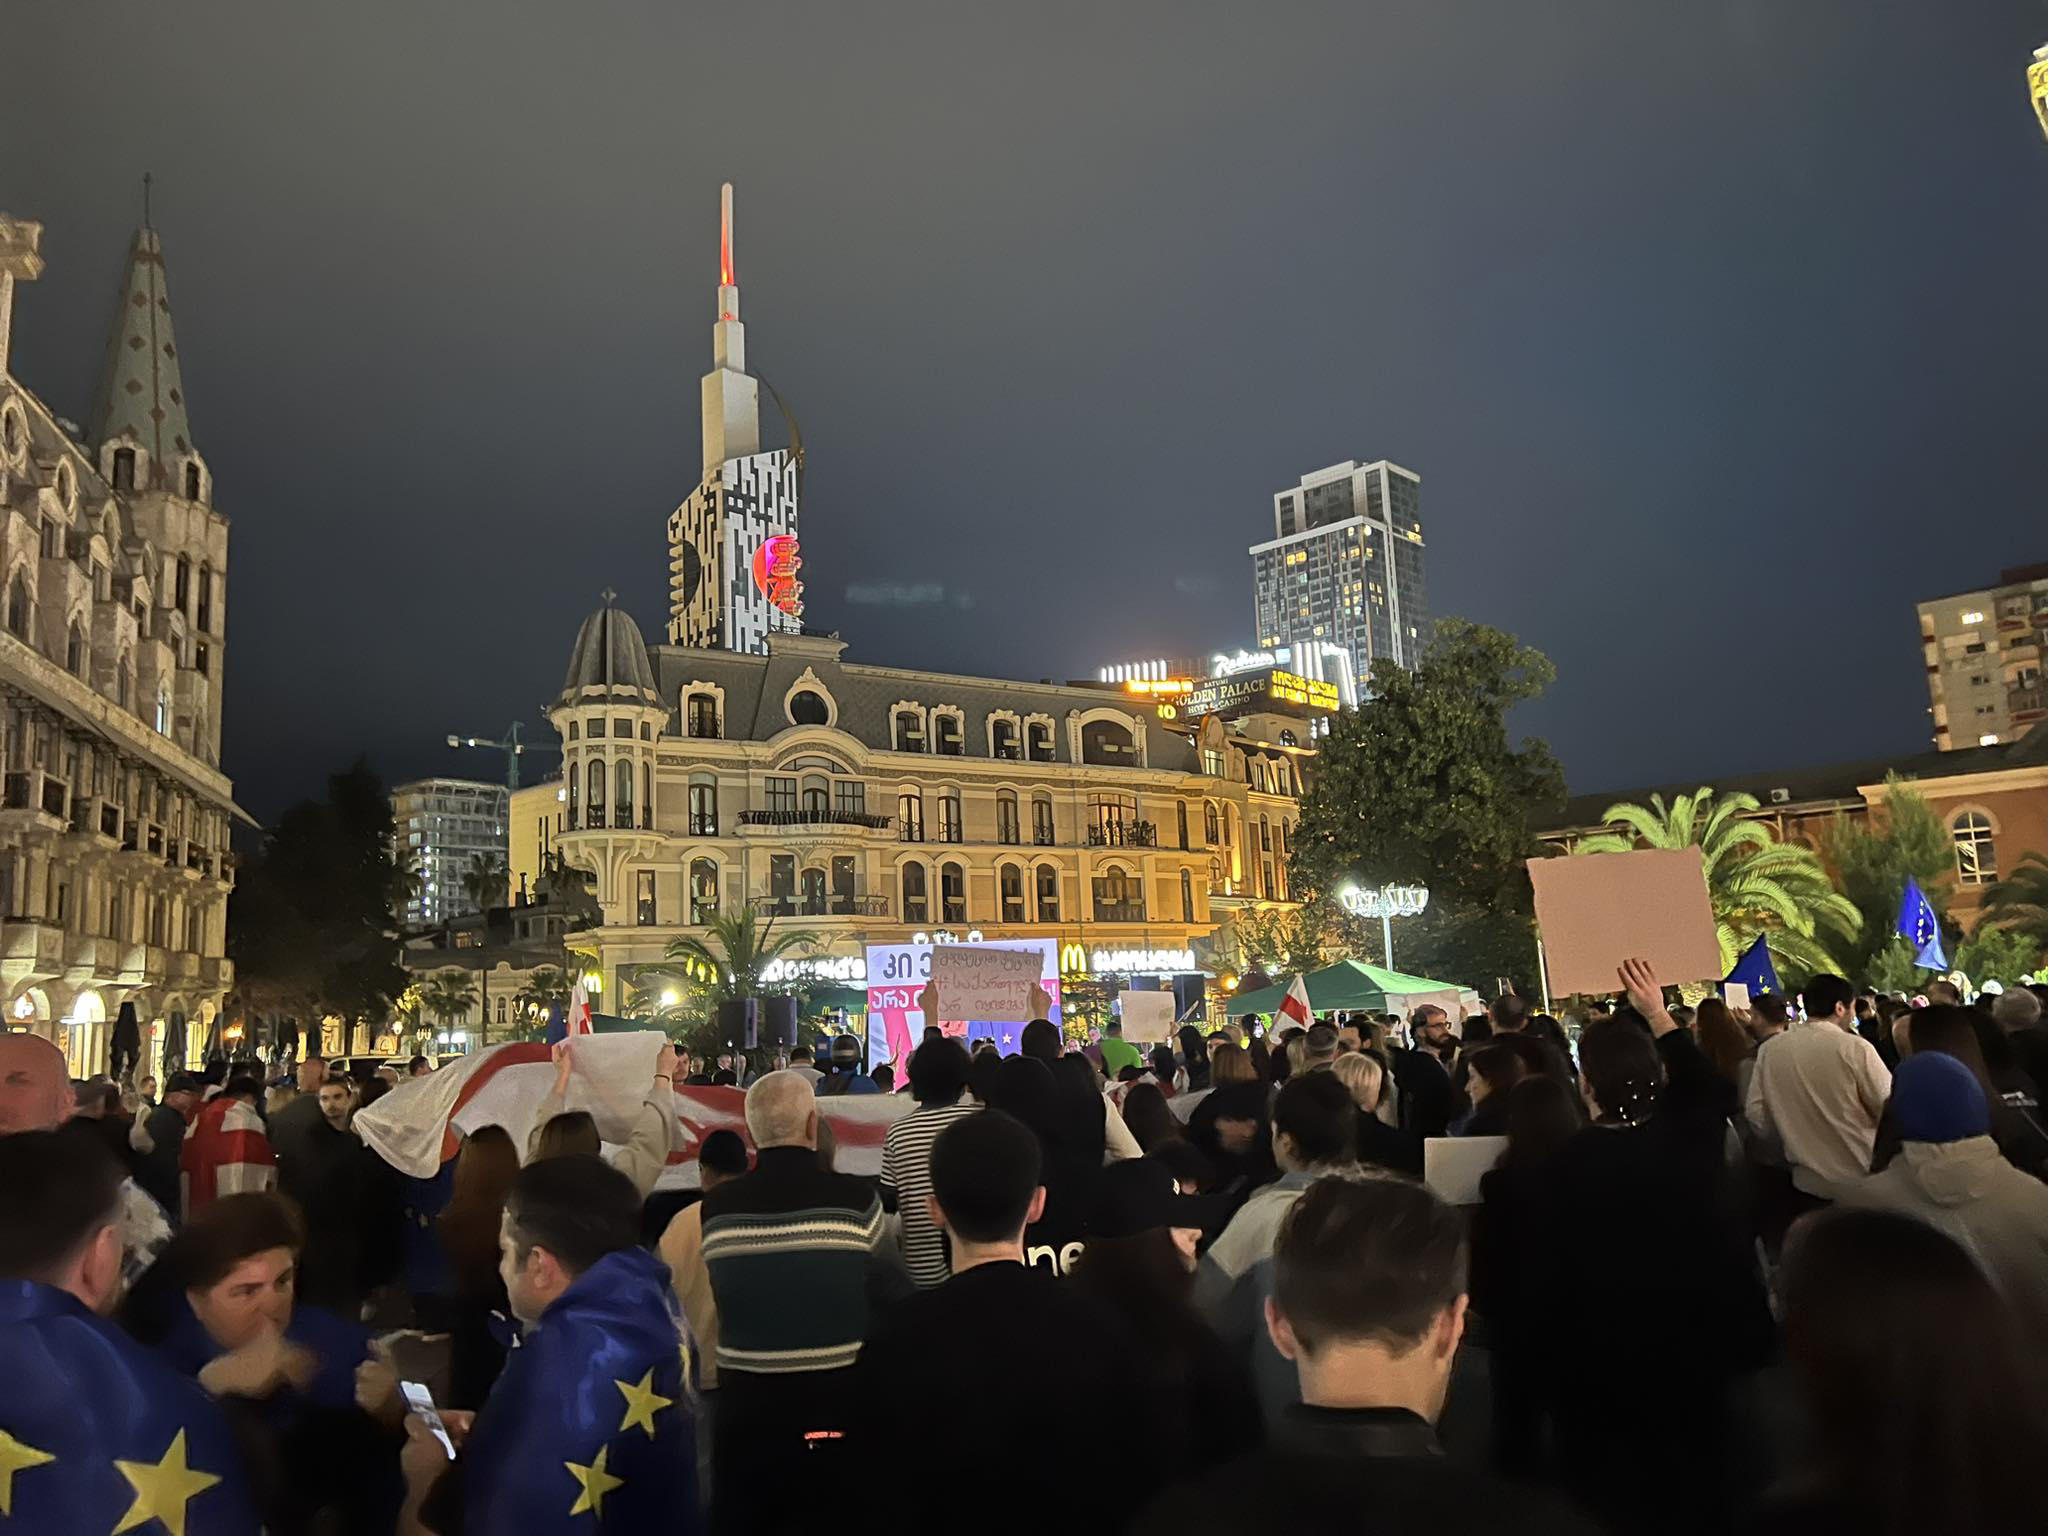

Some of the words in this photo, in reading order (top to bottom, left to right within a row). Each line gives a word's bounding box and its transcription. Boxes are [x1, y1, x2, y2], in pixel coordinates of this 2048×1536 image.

[1204, 679, 1229, 689] BATUMI
[1220, 678, 1266, 699] PALACE
[1220, 695, 1250, 709] CASINO
[883, 953, 912, 979] კი
[872, 989, 910, 1009] არა
[1022, 1241, 1086, 1278] ne
